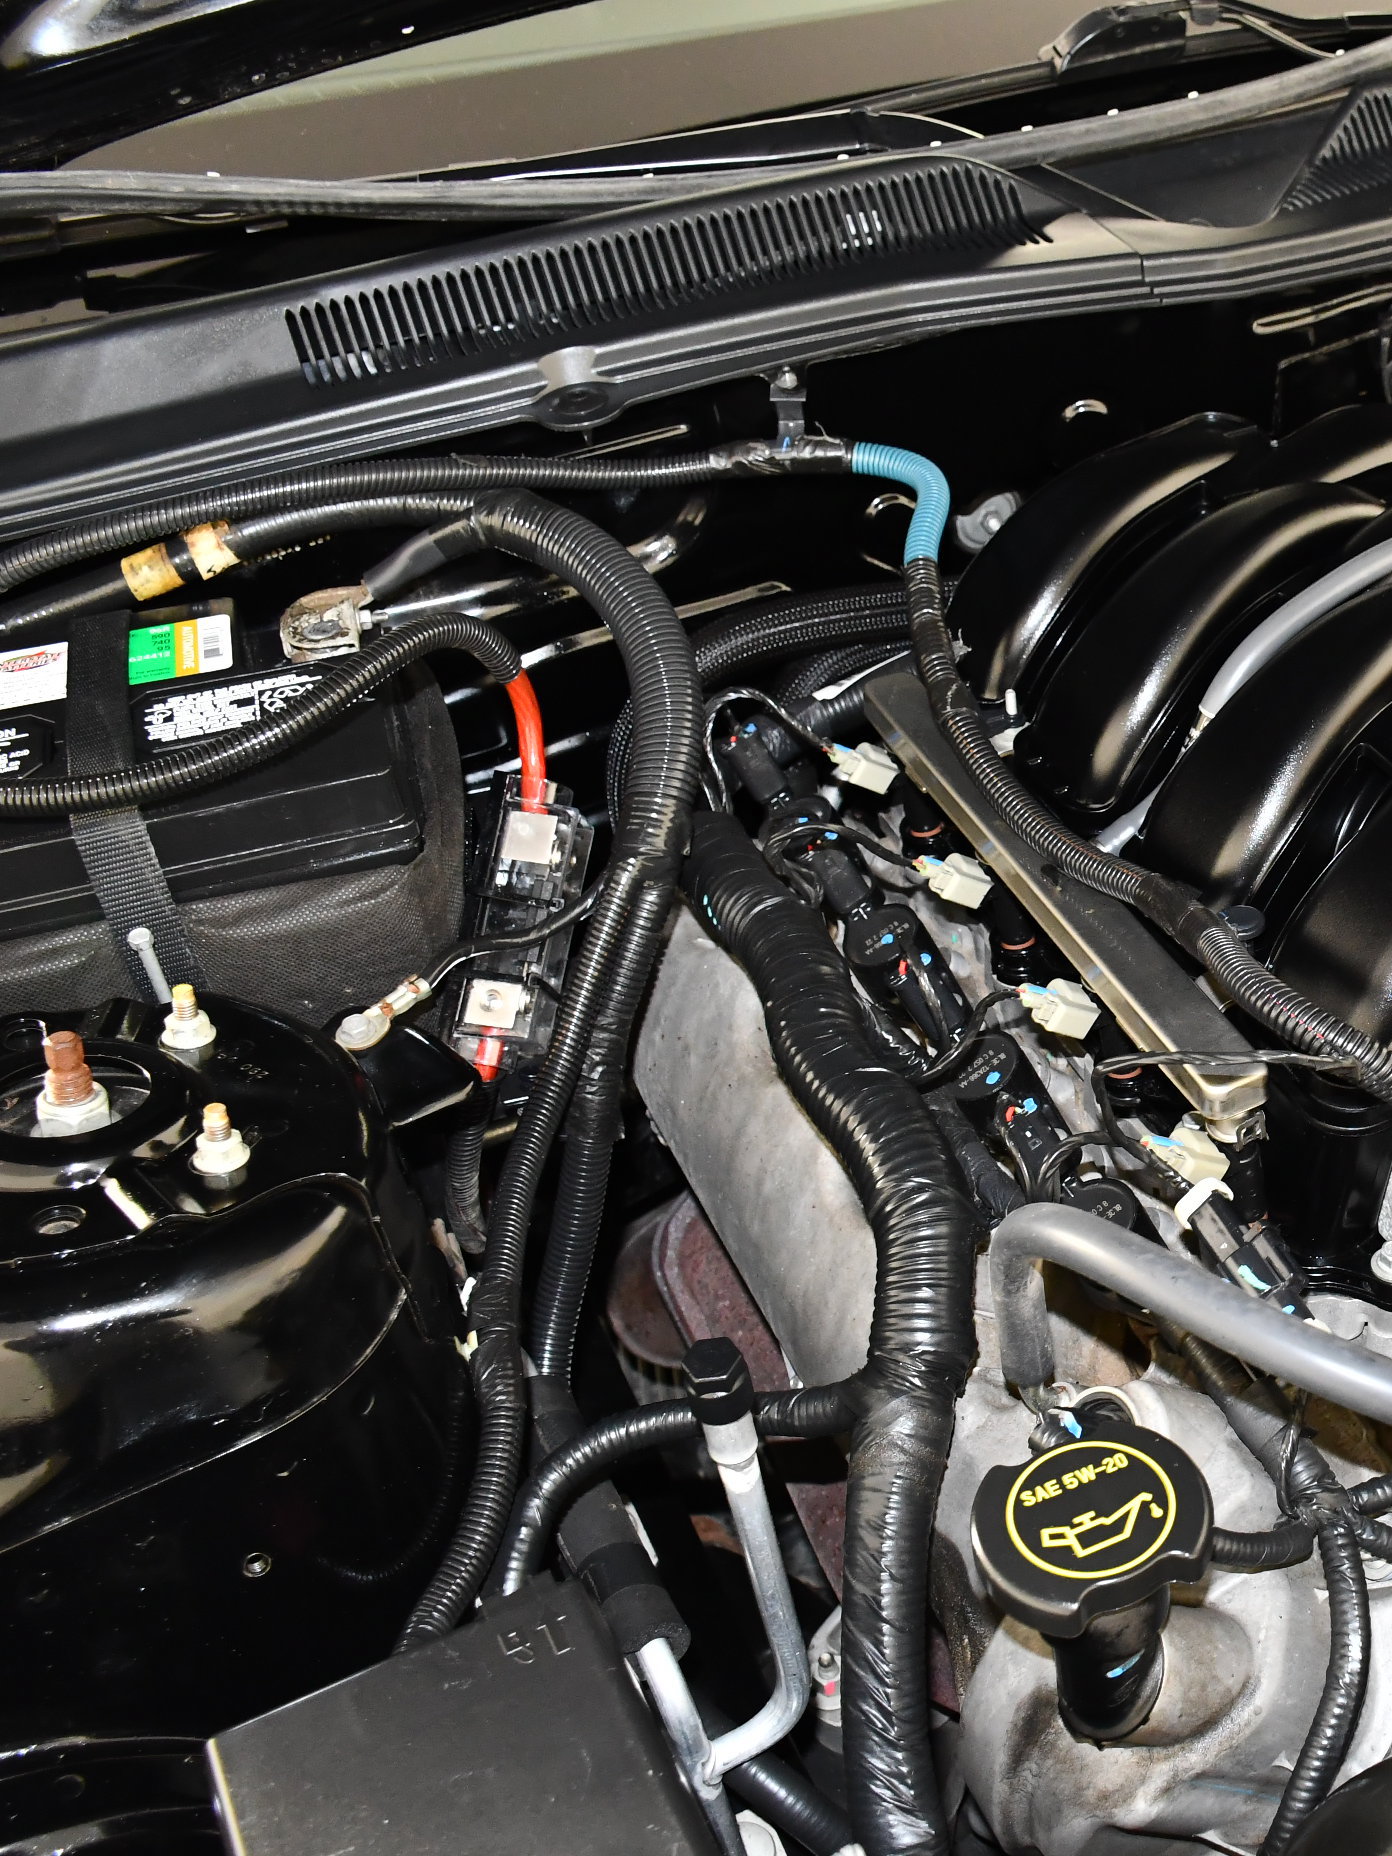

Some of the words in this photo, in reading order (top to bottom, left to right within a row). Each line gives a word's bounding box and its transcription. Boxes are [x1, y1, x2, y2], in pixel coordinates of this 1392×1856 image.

[181, 626, 196, 670] AUTOMOTIVE
[9, 749, 30, 758] ACID
[1103, 1204, 1122, 1218] 8L3E-
[1020, 1479, 1062, 1507] SAE
[1061, 1452, 1129, 1489] 5W-20
